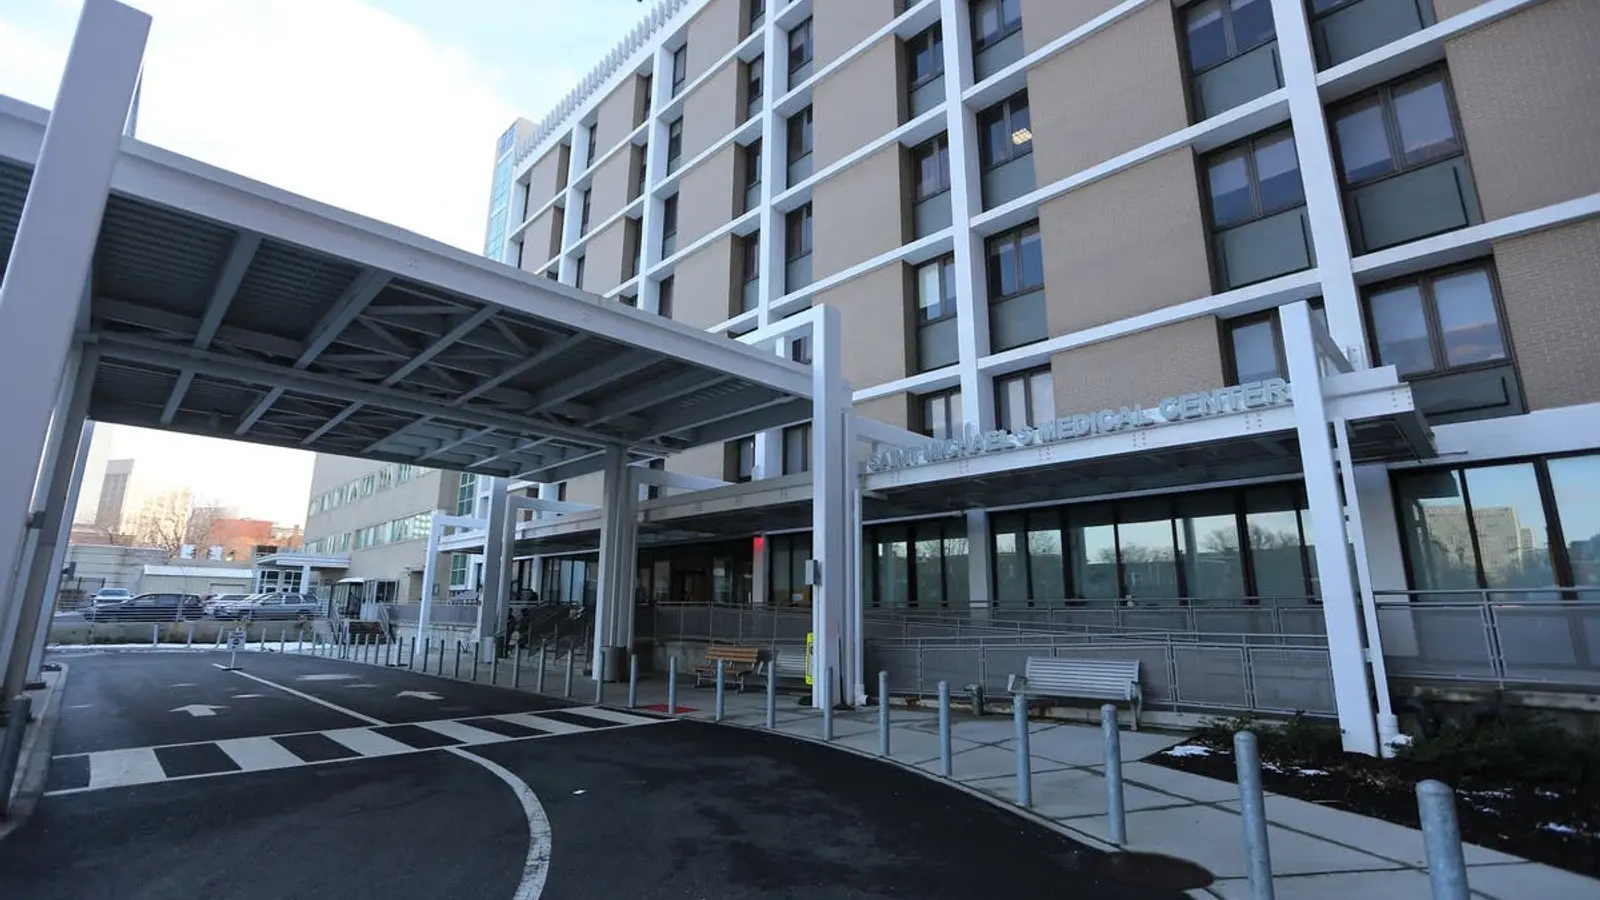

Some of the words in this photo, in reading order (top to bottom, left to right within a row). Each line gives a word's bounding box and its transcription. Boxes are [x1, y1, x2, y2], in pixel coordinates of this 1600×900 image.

[866, 446, 924, 473] SAINT
[1038, 404, 1155, 443] MEDICAL
[1160, 378, 1293, 421] CENTER
